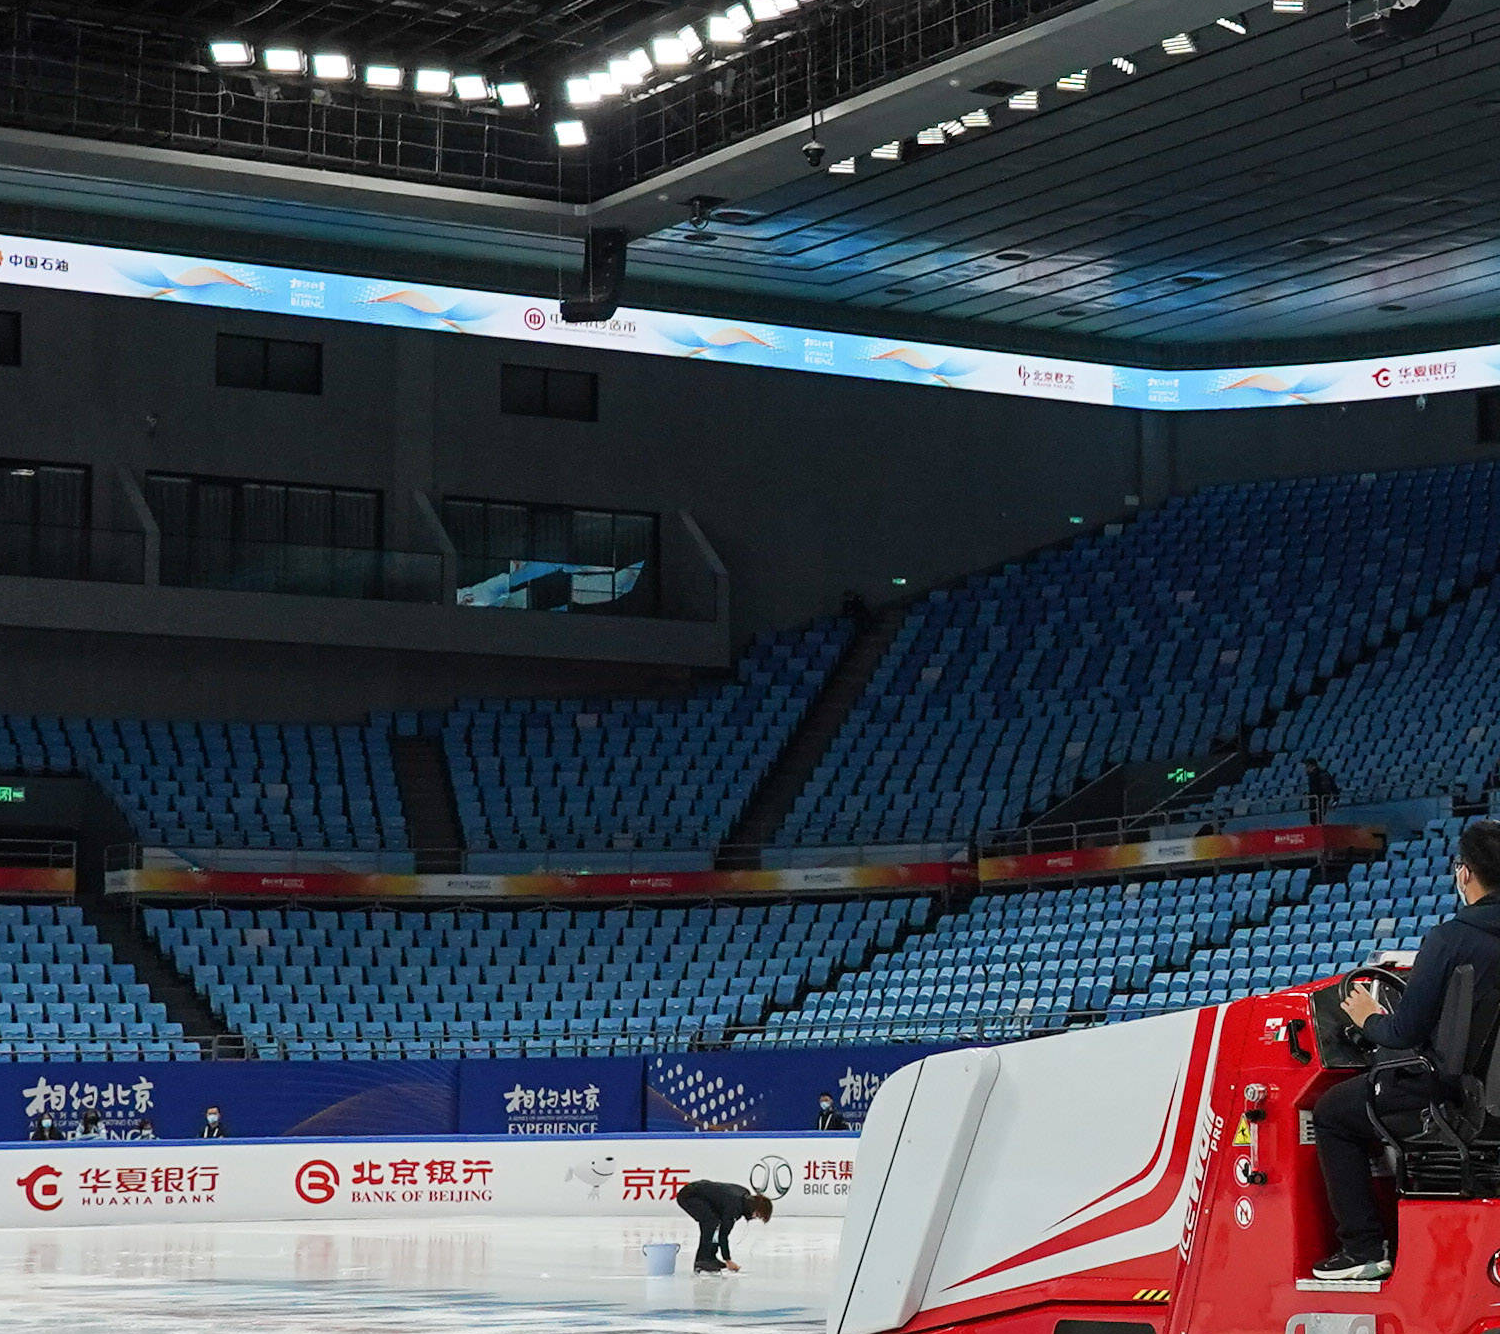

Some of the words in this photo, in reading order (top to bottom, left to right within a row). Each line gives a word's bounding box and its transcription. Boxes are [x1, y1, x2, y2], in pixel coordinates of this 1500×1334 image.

[9, 254, 69, 272] 中国石油
[23, 1076, 154, 1117] 相约北京
[504, 1084, 600, 1113] 相约北京
[1210, 1115, 1225, 1152] PRO
[79, 1166, 220, 1193] 华夏银行
[352, 1159, 494, 1186] 北京银行
[622, 1168, 690, 1200] 京东
[804, 1161, 854, 1180] 北汽集
[82, 1197, 152, 1206] HUAXIA
[165, 1194, 216, 1204] BANK
[352, 1192, 396, 1203] BANK
[401, 1191, 424, 1203] OF
[429, 1190, 493, 1203] BEIJING
[804, 1183, 830, 1195] BAIC
